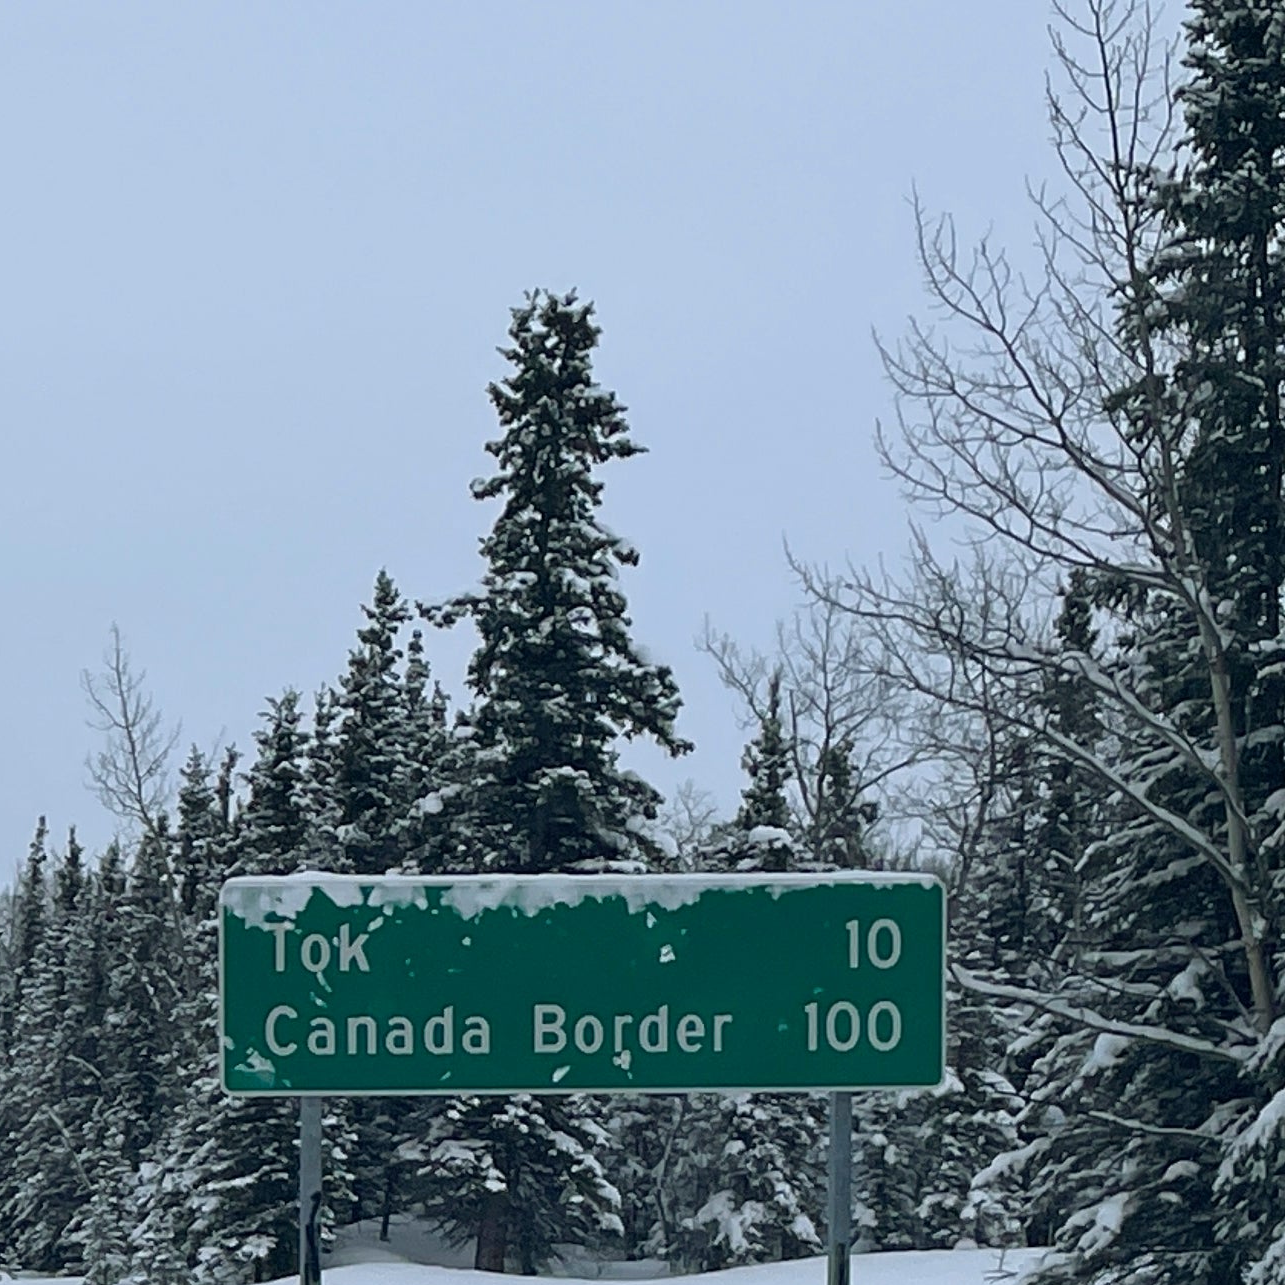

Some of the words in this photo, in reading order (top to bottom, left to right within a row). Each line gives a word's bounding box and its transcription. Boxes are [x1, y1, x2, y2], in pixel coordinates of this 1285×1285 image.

[264, 922, 371, 974] Tok
[845, 918, 903, 970] 10
[264, 1005, 492, 1057] Canada
[533, 1004, 733, 1055] Border
[804, 1001, 903, 1053] 100
